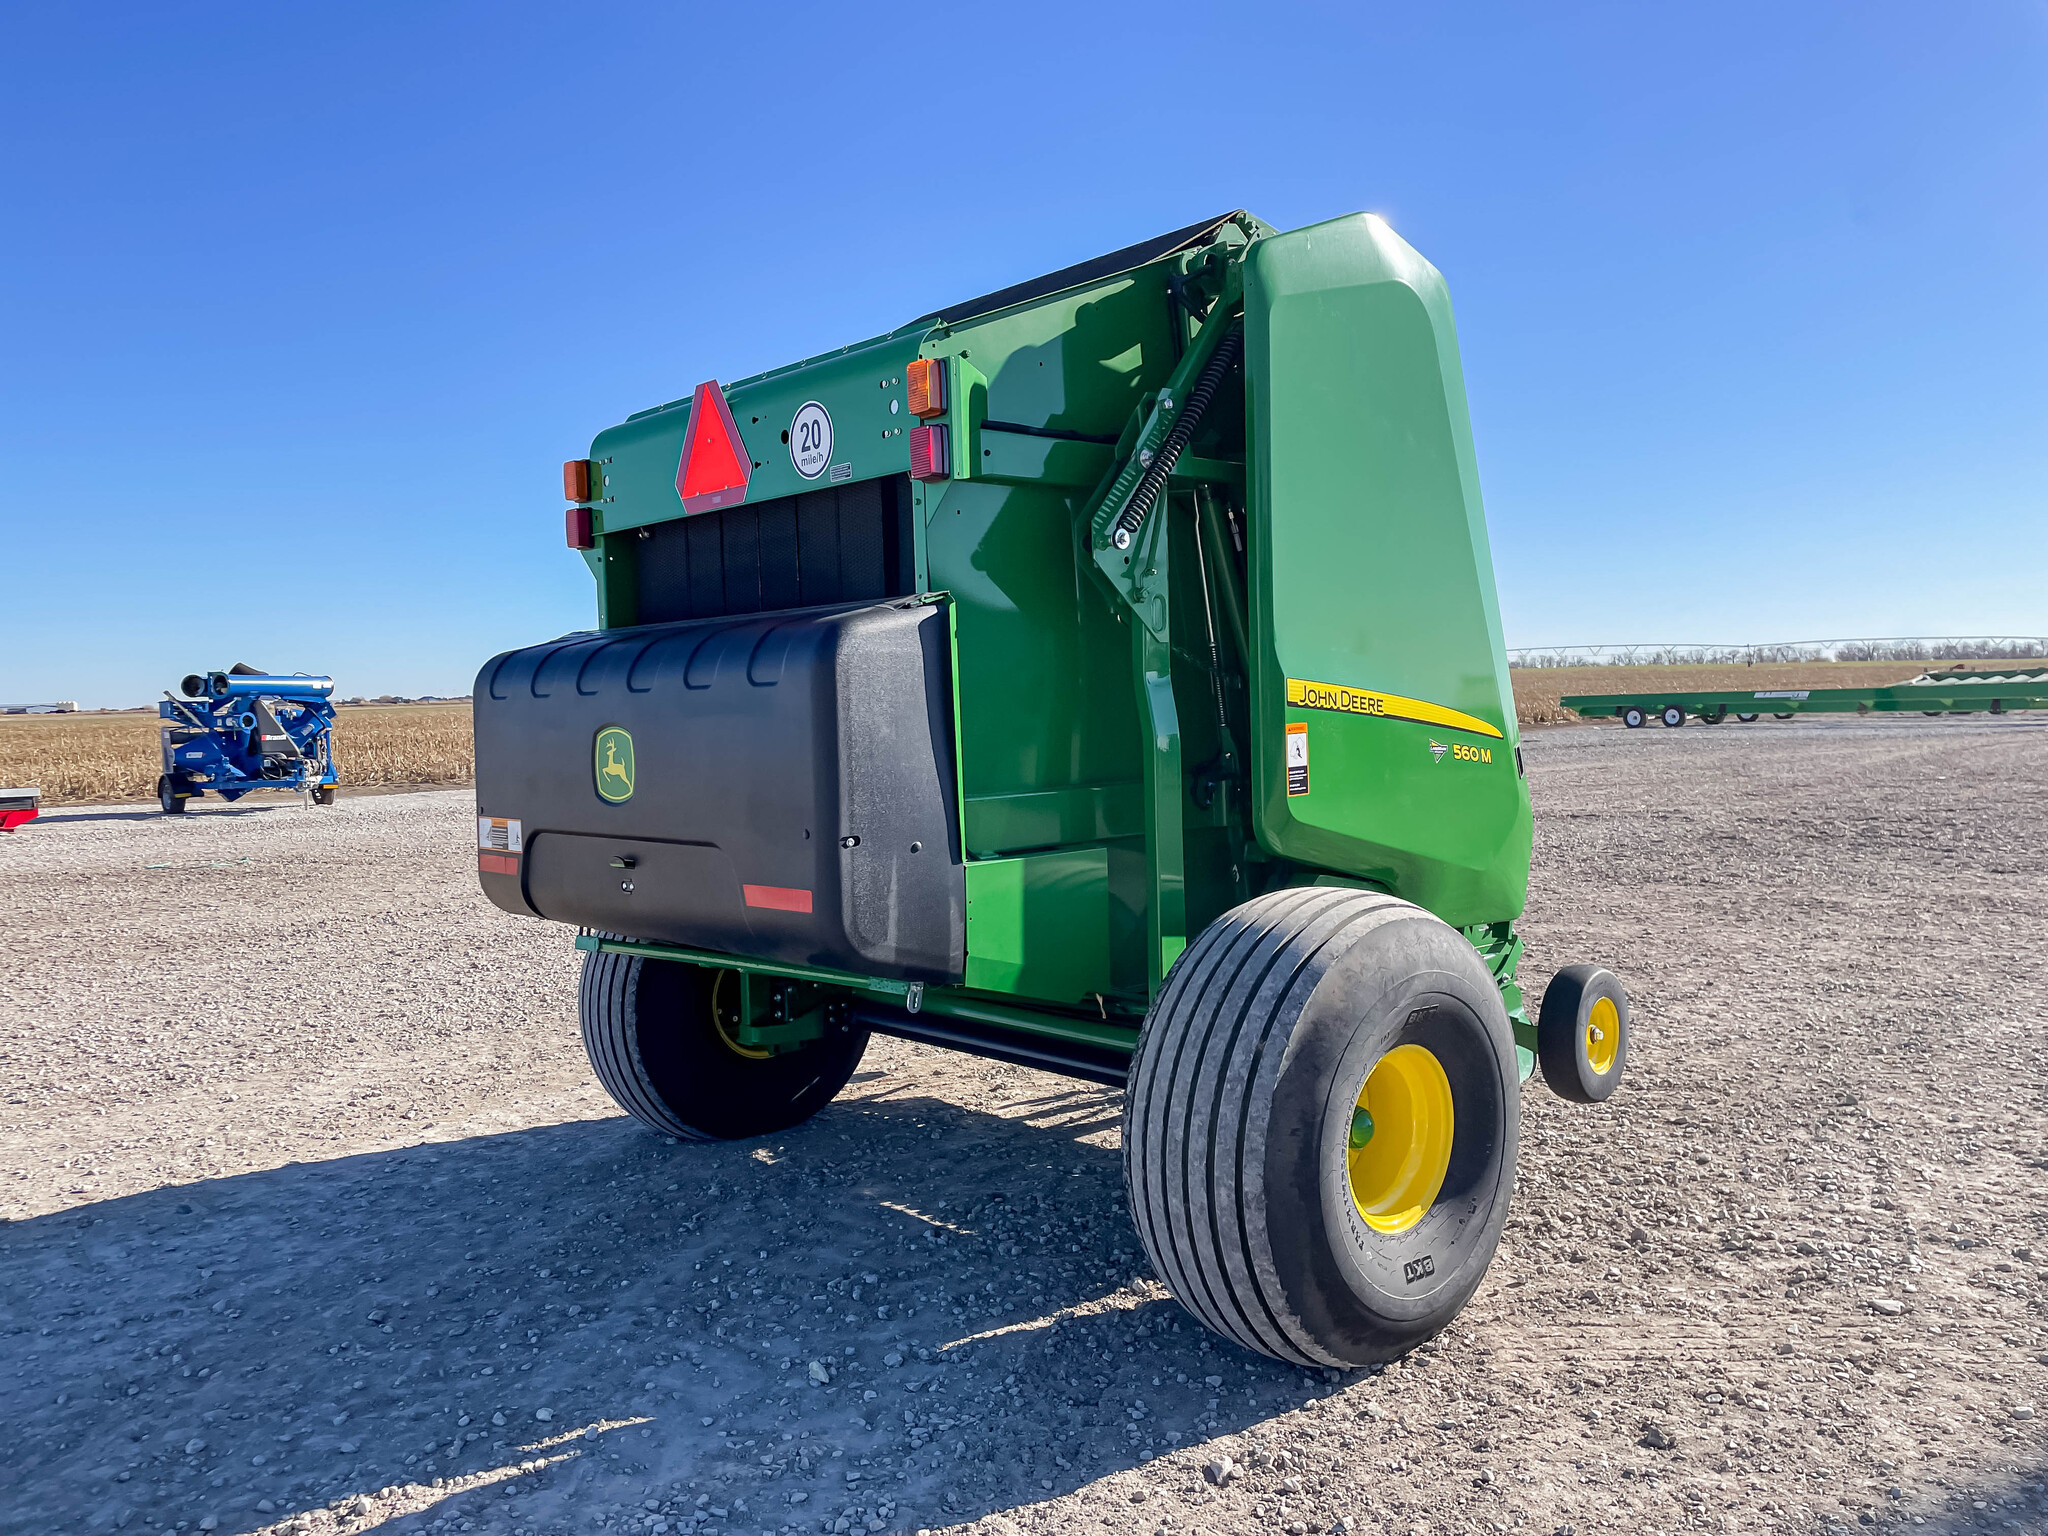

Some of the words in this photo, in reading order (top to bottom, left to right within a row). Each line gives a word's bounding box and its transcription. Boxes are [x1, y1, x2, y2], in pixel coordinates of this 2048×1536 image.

[801, 419, 821, 453] 20
[801, 453, 824, 467] mile/h
[1299, 685, 1337, 707] JOHN
[1341, 690, 1384, 713] DEERE
[1452, 743, 1479, 762] 560
[1480, 748, 1492, 764] M
[1405, 1257, 1434, 1283] BKT
